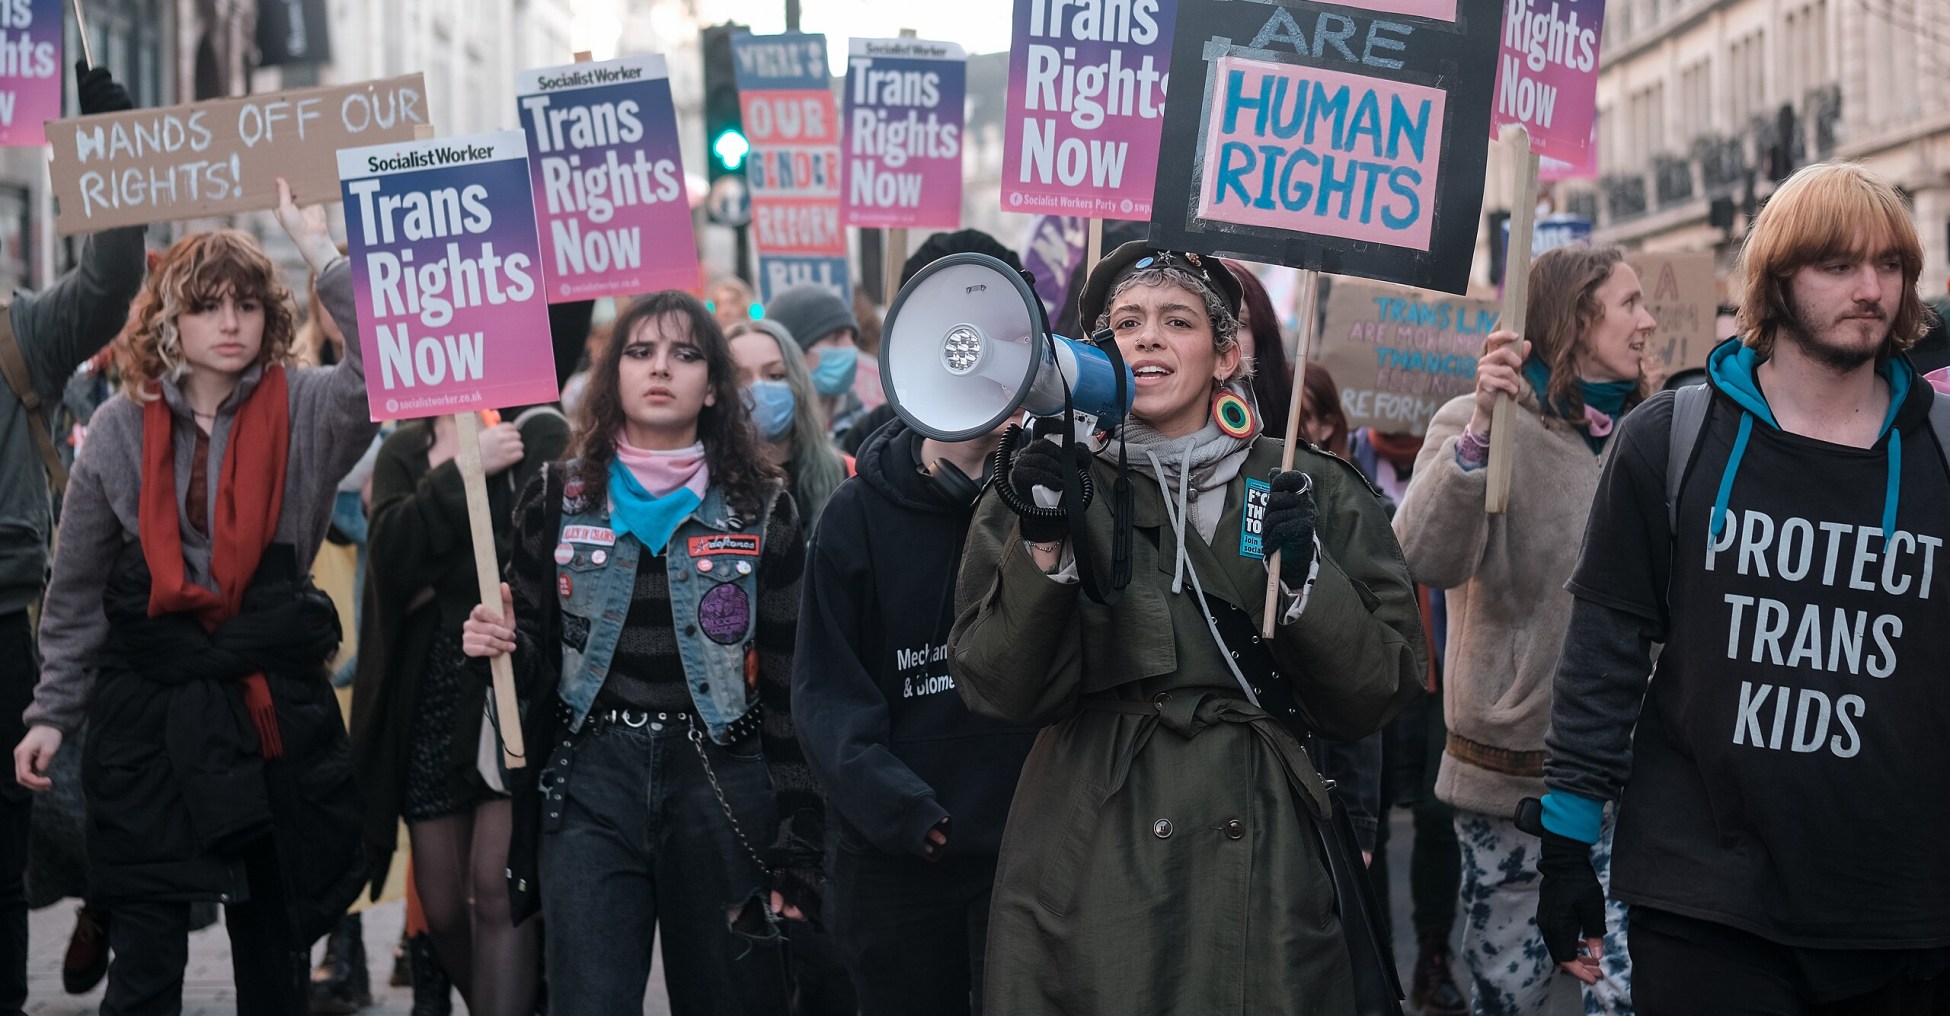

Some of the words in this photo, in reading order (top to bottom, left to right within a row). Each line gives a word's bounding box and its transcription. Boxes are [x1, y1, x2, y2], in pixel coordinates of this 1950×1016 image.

[0, 30, 56, 79] hts
[865, 43, 910, 56] Socialist
[911, 45, 947, 57] Worker
[1250, 7, 1416, 70] ARE
[1505, 0, 1596, 73] Rights
[538, 70, 593, 90] Socialist
[594, 66, 642, 83] Worker
[850, 58, 940, 108] Trans
[1499, 54, 1557, 129] Now
[76, 110, 212, 163] HANDS
[238, 98, 323, 148] OFF
[341, 88, 422, 133] OUR
[522, 95, 644, 152] Trans
[751, 97, 826, 138] OUR
[852, 108, 960, 168] Rights
[1221, 69, 1431, 164] HUMAN
[368, 150, 435, 173] Socialist
[435, 144, 494, 165] Worker
[751, 151, 839, 190] GENDER
[1020, 117, 1128, 189] Now
[79, 151, 243, 218] RIGHTS!
[541, 150, 680, 224] Rights
[850, 159, 922, 208] Now
[1024, 194, 1058, 208] Socialist
[1060, 196, 1093, 210] Workers
[1095, 198, 1117, 212] Party
[1215, 141, 1423, 230] RIGHTS
[349, 179, 492, 246] Trans
[757, 204, 840, 248] REFORM
[551, 218, 641, 277] Now
[366, 242, 535, 328] Rights
[1348, 320, 1387, 344] ARE
[1373, 296, 1452, 330] TRANS
[375, 323, 484, 391] Now
[400, 391, 482, 410] socialistworker.co.uk
[1341, 387, 1436, 422] REFORM
[1247, 502, 1265, 520] TH
[1248, 488, 1270, 507] FC
[709, 536, 755, 550] deftones
[1705, 505, 1943, 600] PROTECT
[1724, 593, 1903, 679] TRANS
[903, 677, 913, 698] &
[1733, 680, 1866, 759] KIDS
